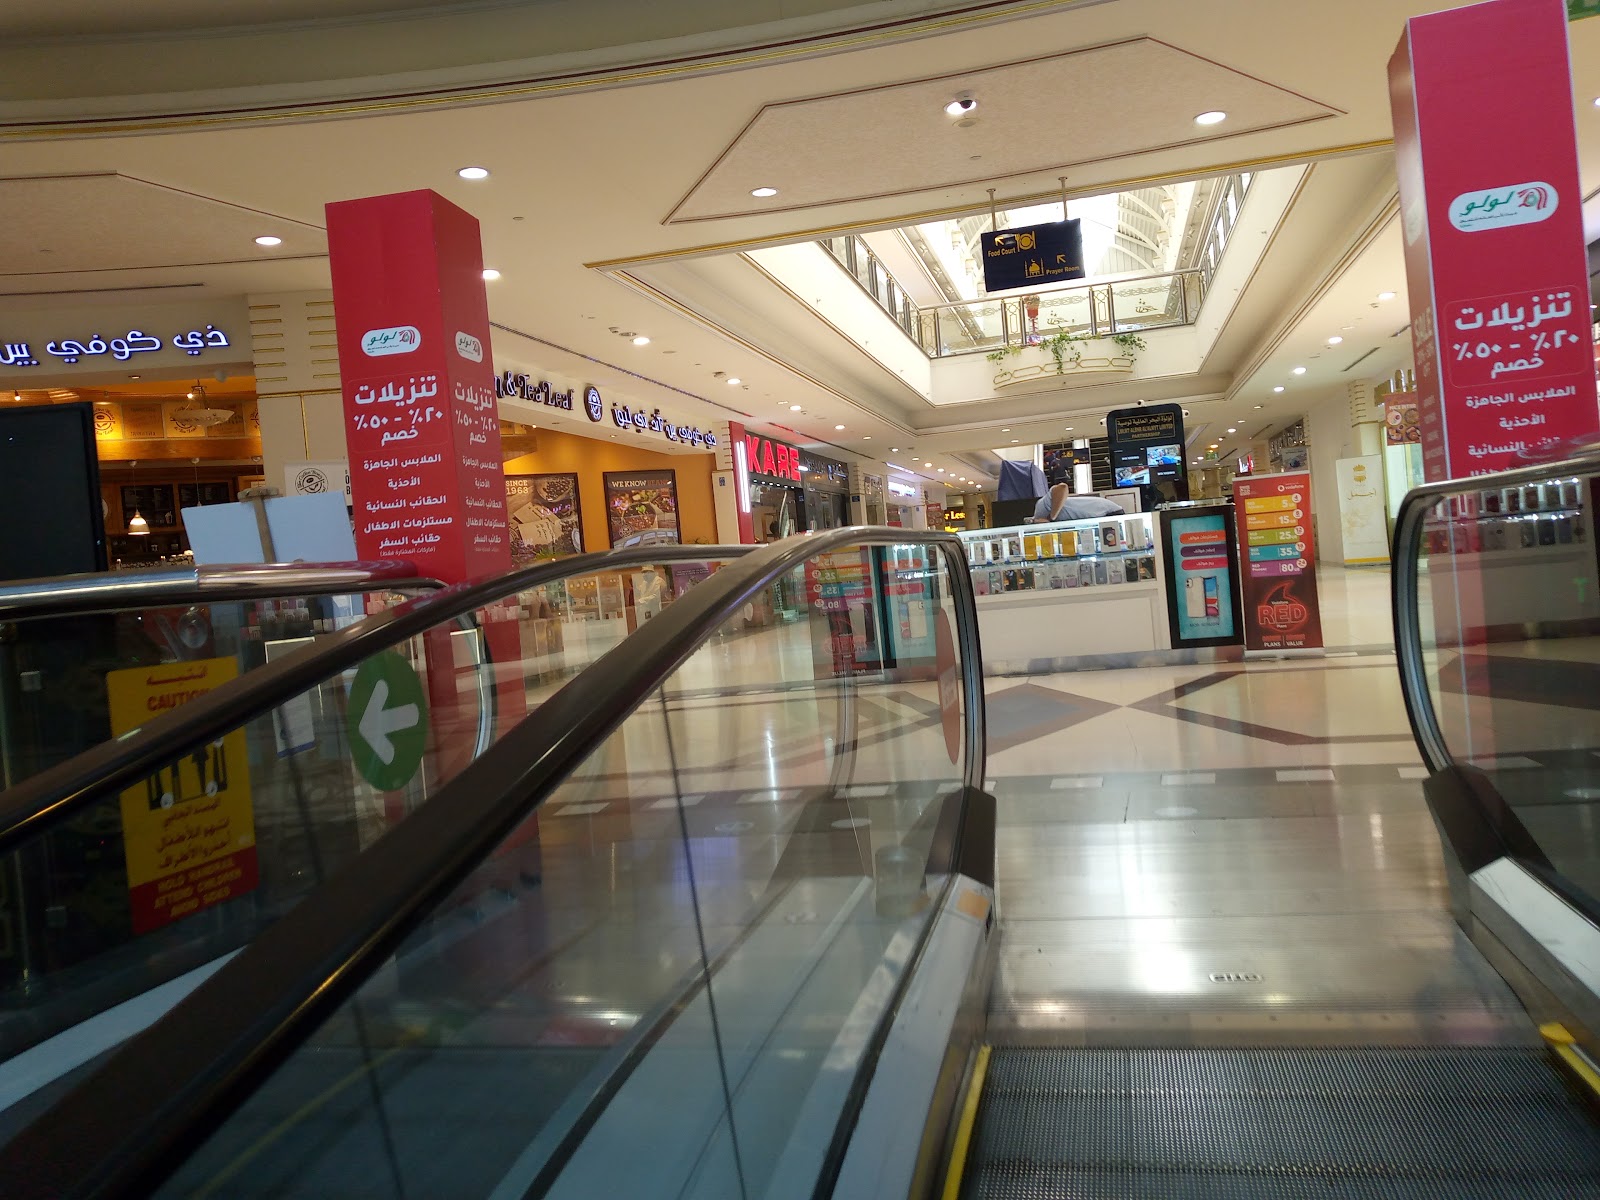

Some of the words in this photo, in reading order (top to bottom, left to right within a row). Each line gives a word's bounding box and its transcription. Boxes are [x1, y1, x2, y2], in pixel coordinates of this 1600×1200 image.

[988, 248, 1000, 257] Food
[1001, 247, 1016, 255] Court
[1455, 292, 1572, 331] تنزيلات
[46, 330, 162, 363] كوفي
[173, 325, 229, 355] ذي
[1491, 353, 1544, 379] خصم
[355, 375, 437, 407] تنزيلات
[455, 382, 493, 411] تنزيلات
[505, 370, 516, 396] &
[516, 373, 542, 402] Tea
[542, 381, 574, 410] Leaf
[1518, 386, 1576, 403] الملابس
[1466, 393, 1514, 408] الجاهزة
[1499, 414, 1545, 430] الأحذية
[381, 426, 418, 446] خصم
[470, 432, 486, 444] خصم
[401, 454, 441, 468] الملابس
[463, 456, 479, 467] الجاهزة
[745, 434, 801, 481] KARE
[364, 459, 397, 471] الجاهزة
[480, 461, 498, 470] الملابس
[388, 476, 420, 490] الأحذية
[366, 500, 406, 513] النسائية
[410, 496, 446, 509] الحقائب
[1282, 500, 1288, 508] 5
[403, 516, 452, 528] مستلزمات
[1279, 516, 1289, 524] 15
[379, 536, 408, 549] السفر
[411, 533, 441, 544] حقائب
[1280, 548, 1292, 556] 35
[1258, 604, 1306, 624] RED
